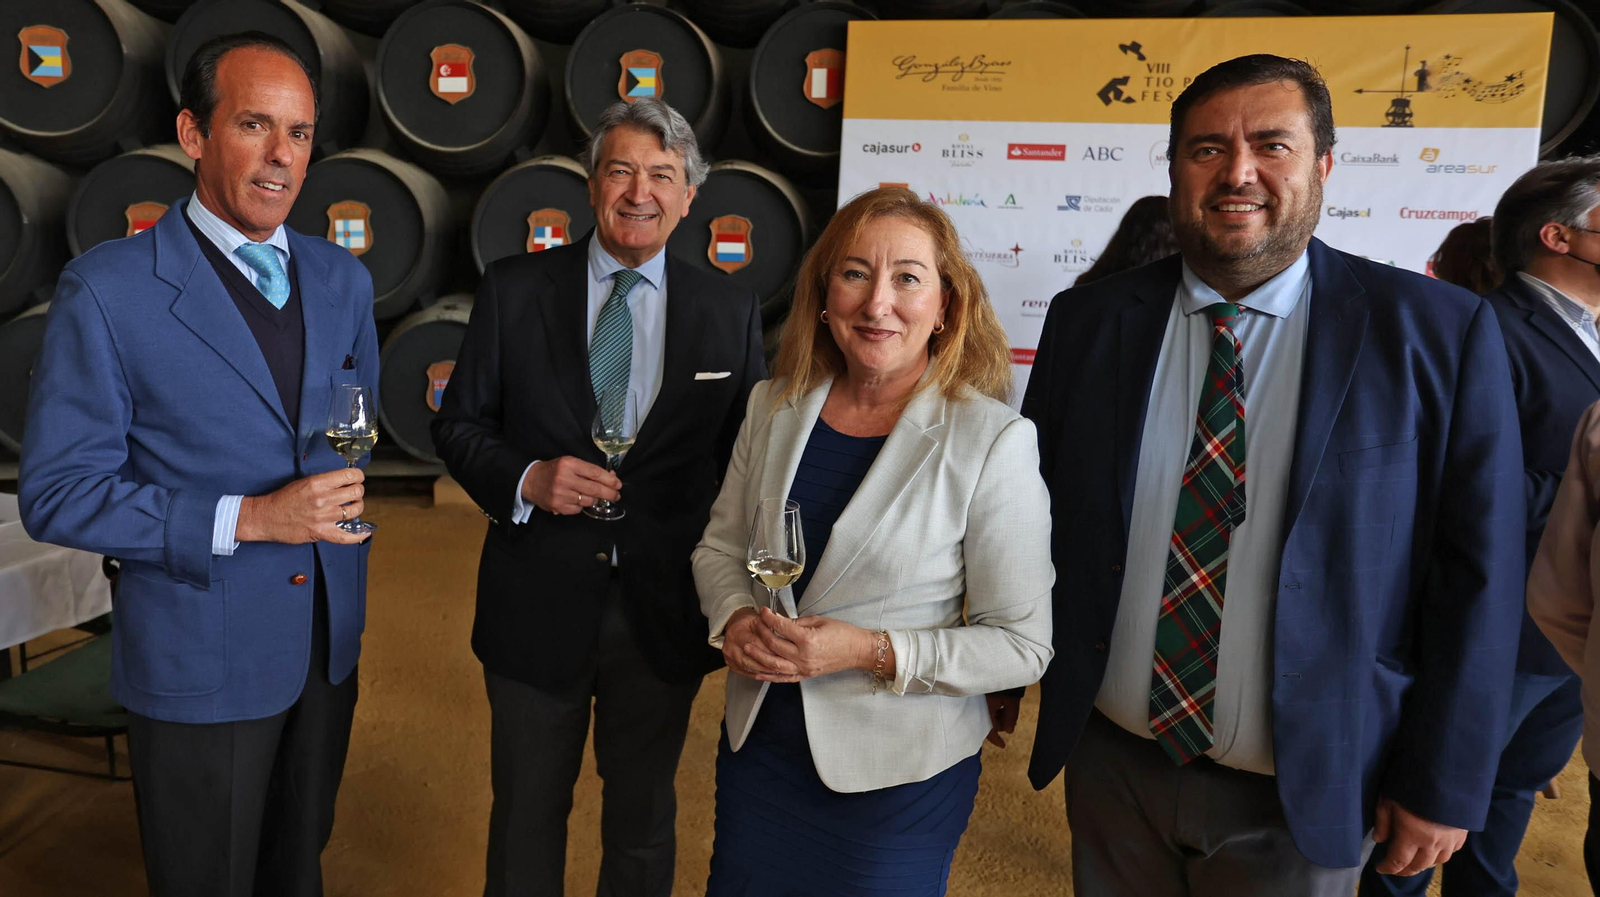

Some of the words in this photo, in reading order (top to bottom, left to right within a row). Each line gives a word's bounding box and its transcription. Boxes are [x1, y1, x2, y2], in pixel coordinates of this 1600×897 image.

[1146, 63, 1171, 74] VIII
[1143, 77, 1174, 88] TIO
[1183, 77, 1192, 88] P
[1141, 91, 1181, 102] FES
[862, 142, 910, 155] cajasur
[941, 149, 984, 159] BLISS
[1022, 148, 1063, 158] Santander
[1082, 147, 1124, 162] ABC
[1340, 152, 1400, 164] CaixaBank
[1425, 164, 1498, 174] areasur
[926, 191, 989, 208] Andalucía
[1083, 195, 1121, 205] Diputación
[1327, 207, 1371, 219] Cajasol
[1399, 206, 1478, 222] Cruzcampo
[962, 251, 1014, 261] ONTESIERRA
[1053, 254, 1098, 265] BLISS
[1022, 300, 1048, 308] ren
